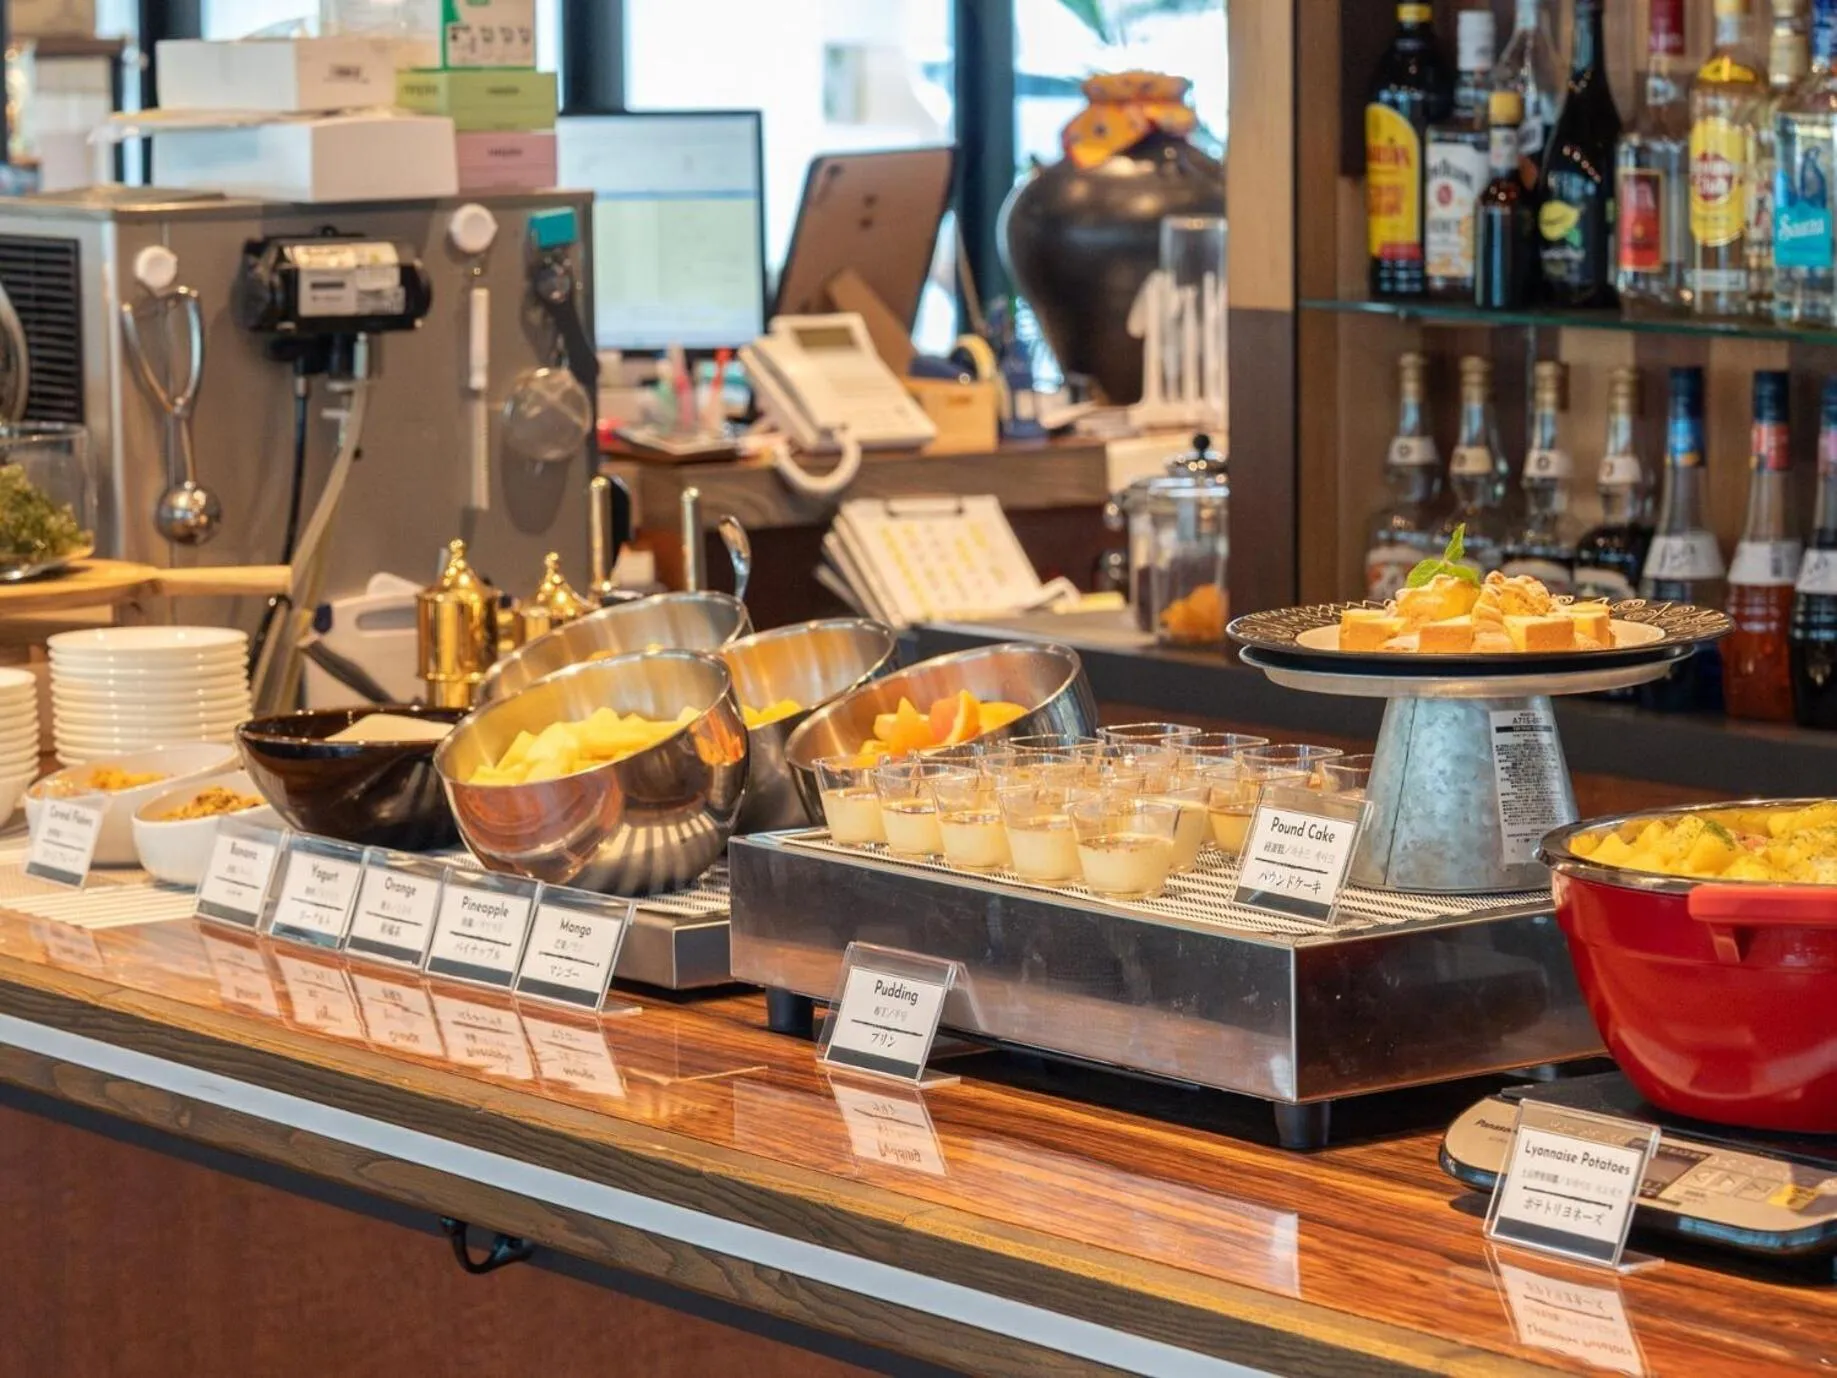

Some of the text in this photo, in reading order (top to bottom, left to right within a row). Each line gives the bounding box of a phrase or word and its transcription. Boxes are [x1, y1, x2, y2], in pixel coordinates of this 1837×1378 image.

[1270, 816, 1336, 843] Pound Cake
[311, 863, 340, 883] Yogurt
[1258, 871, 1323, 895] パウンドケーキ
[384, 876, 417, 898] Orange
[461, 895, 510, 918] Pineapple
[560, 918, 593, 938] Mango
[549, 964, 581, 979] マンゴー
[874, 979, 919, 1006] Pudding
[870, 1032, 898, 1048] プリン
[1525, 1139, 1631, 1176] Lyonnaise Potatoes
[1522, 1197, 1605, 1226] ポテトリヨネーズ
